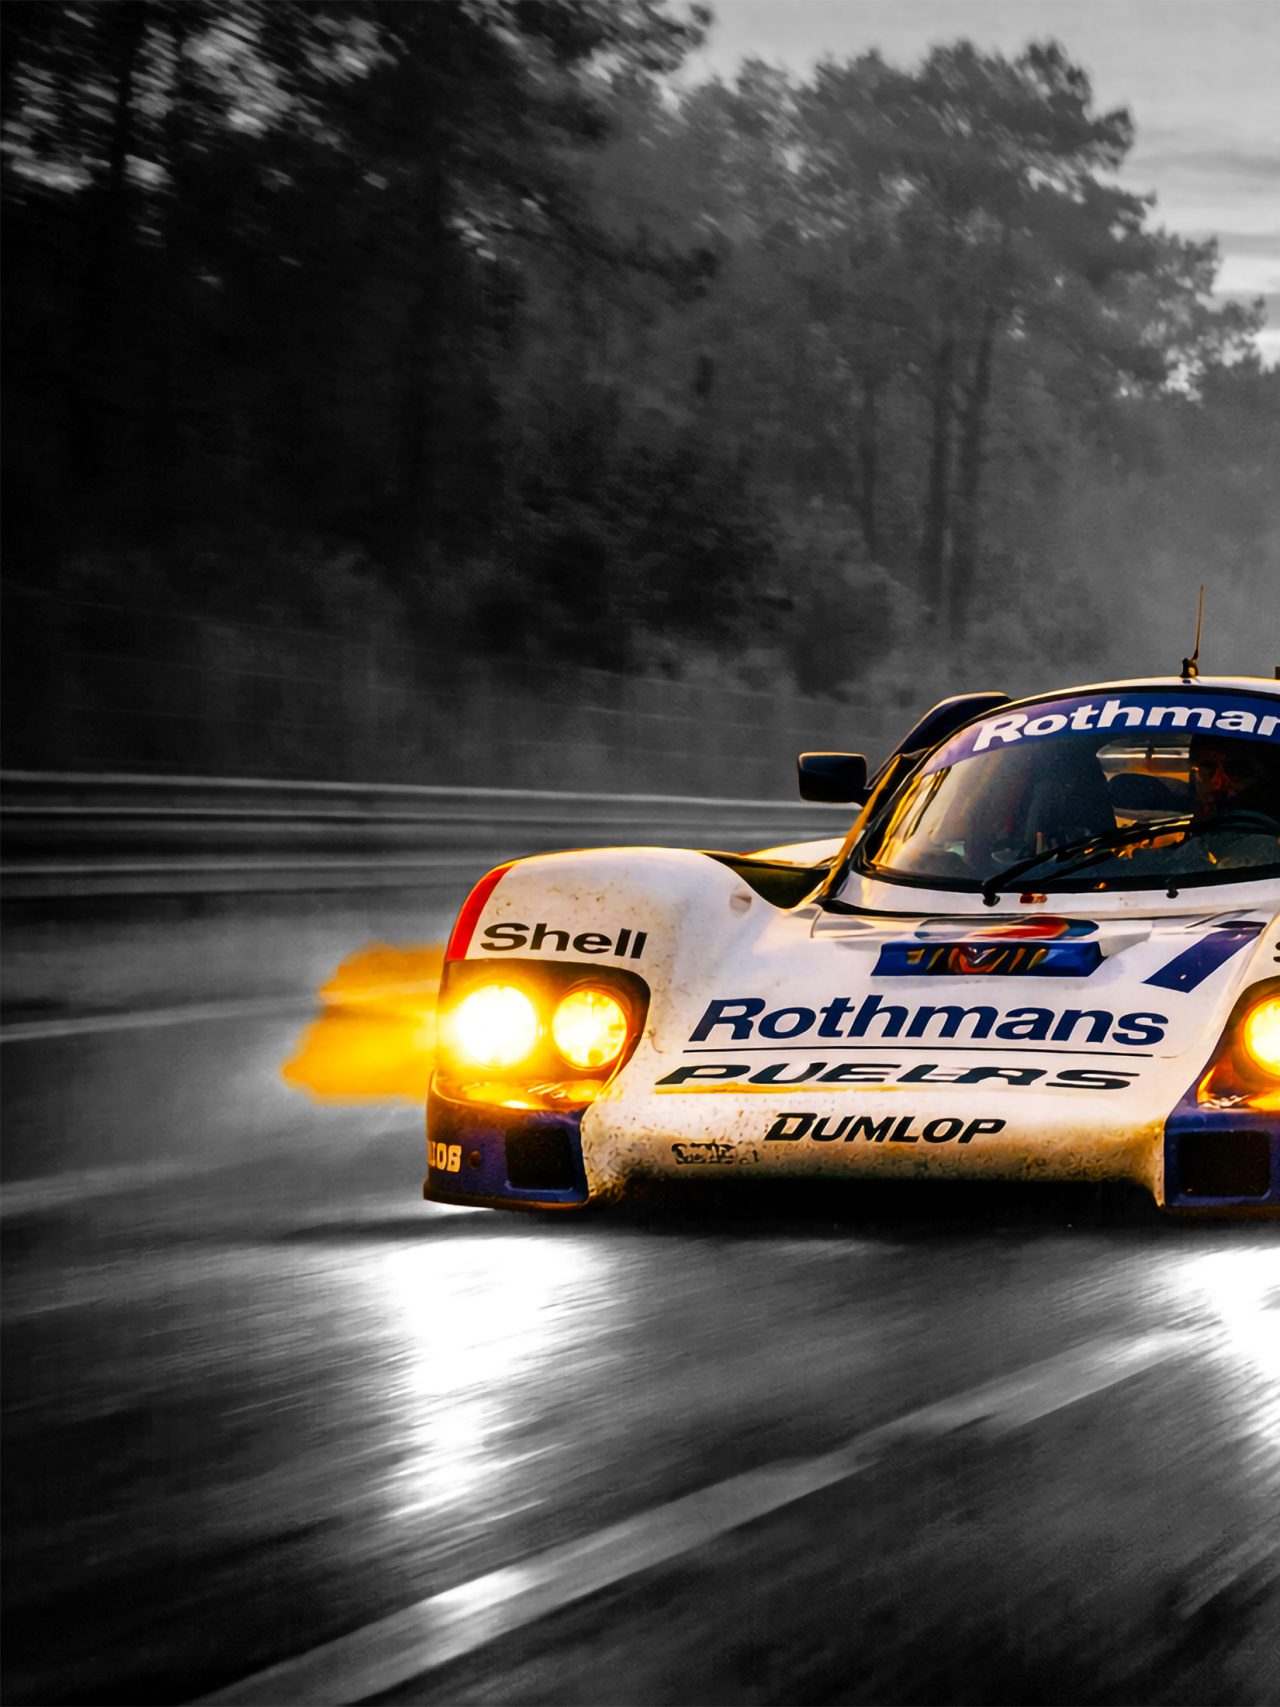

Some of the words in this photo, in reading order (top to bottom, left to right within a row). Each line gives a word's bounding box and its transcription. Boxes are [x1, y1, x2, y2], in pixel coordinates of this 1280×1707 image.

[480, 922, 648, 959] Shell
[688, 995, 1169, 1046] Rothmans
[764, 1112, 1006, 1144] DUMLOP
